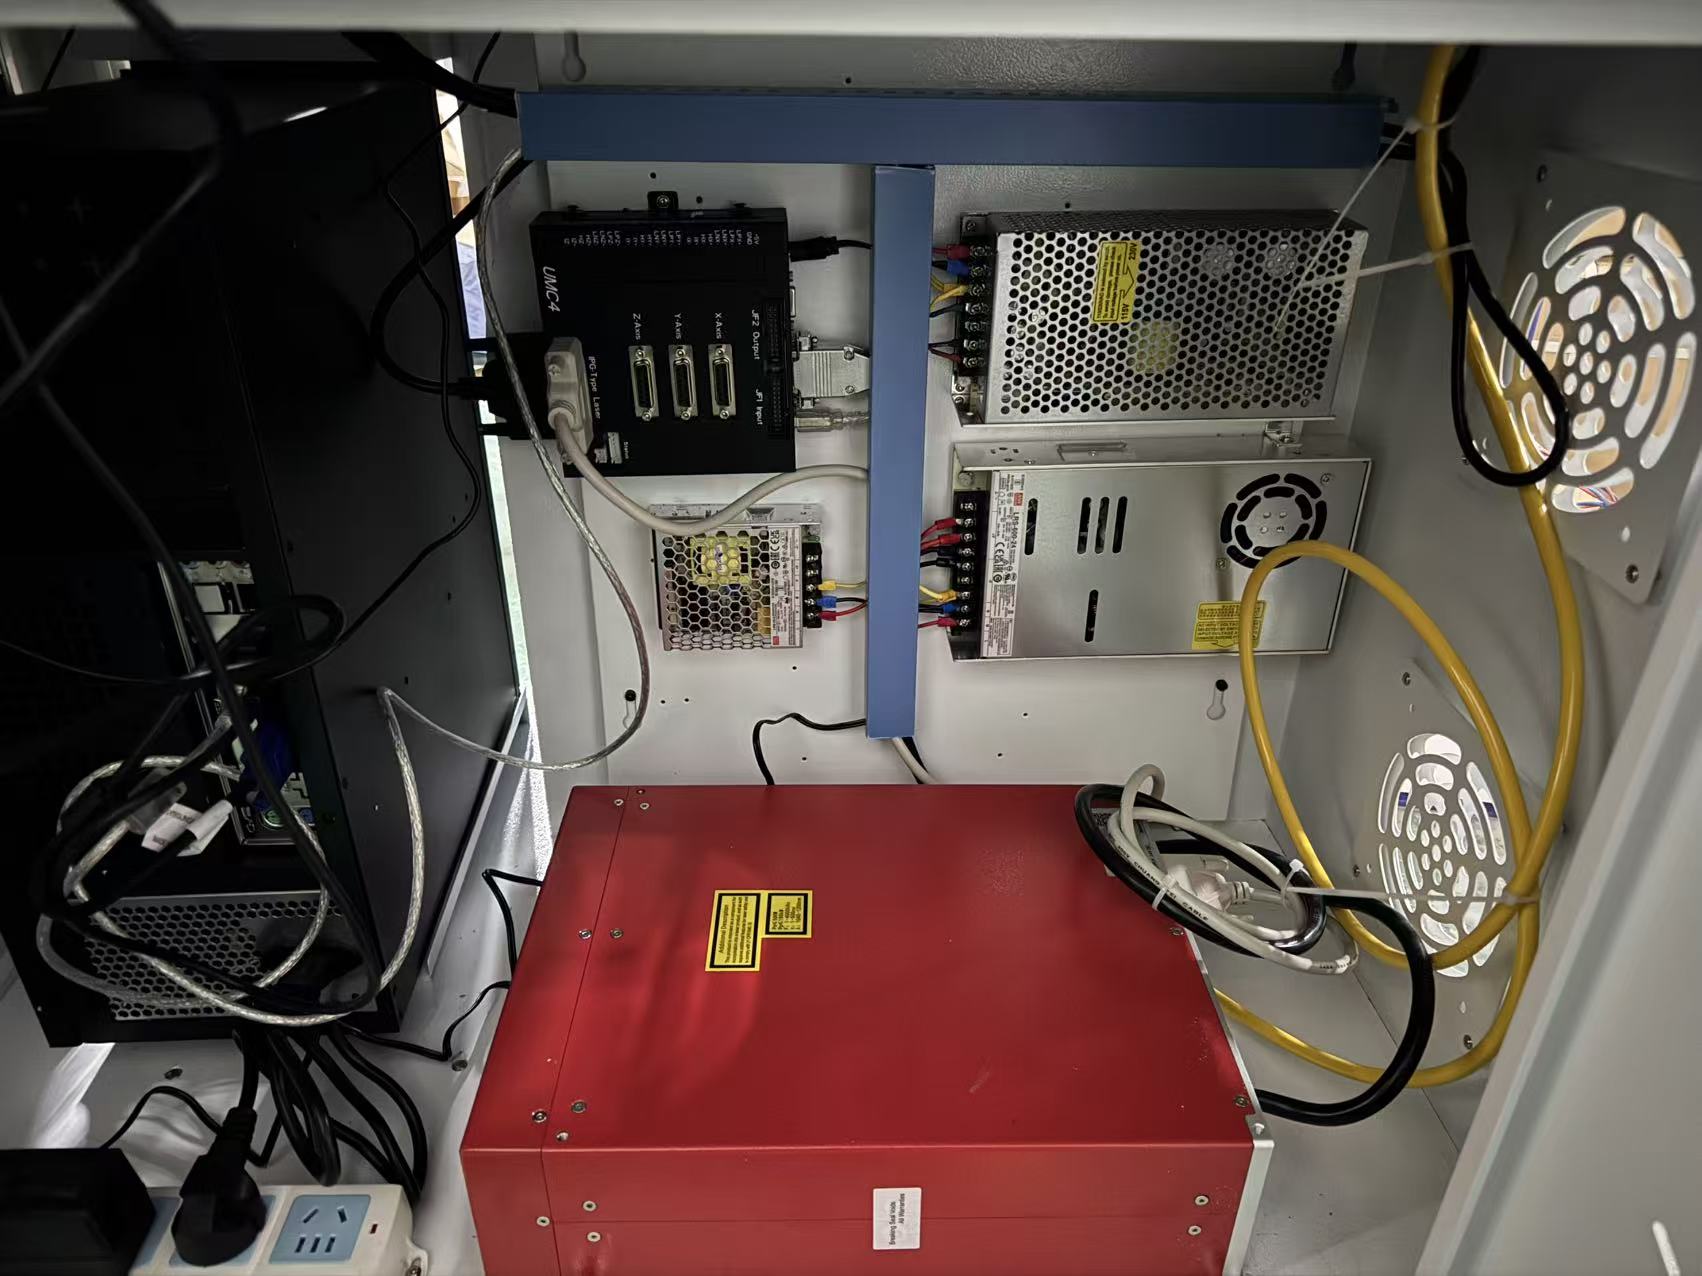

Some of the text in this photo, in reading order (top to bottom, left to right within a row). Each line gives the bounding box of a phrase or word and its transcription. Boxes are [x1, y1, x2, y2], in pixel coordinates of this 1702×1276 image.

[542, 266, 560, 312] UMC4
[1121, 303, 1129, 320] 115V
[633, 313, 641, 340] Z-Axis
[674, 313, 682, 340] Y-Axis
[752, 309, 760, 360] JF2 Output
[1182, 902, 1209, 921] CABLE
[889, 1225, 897, 1245] Breaking
